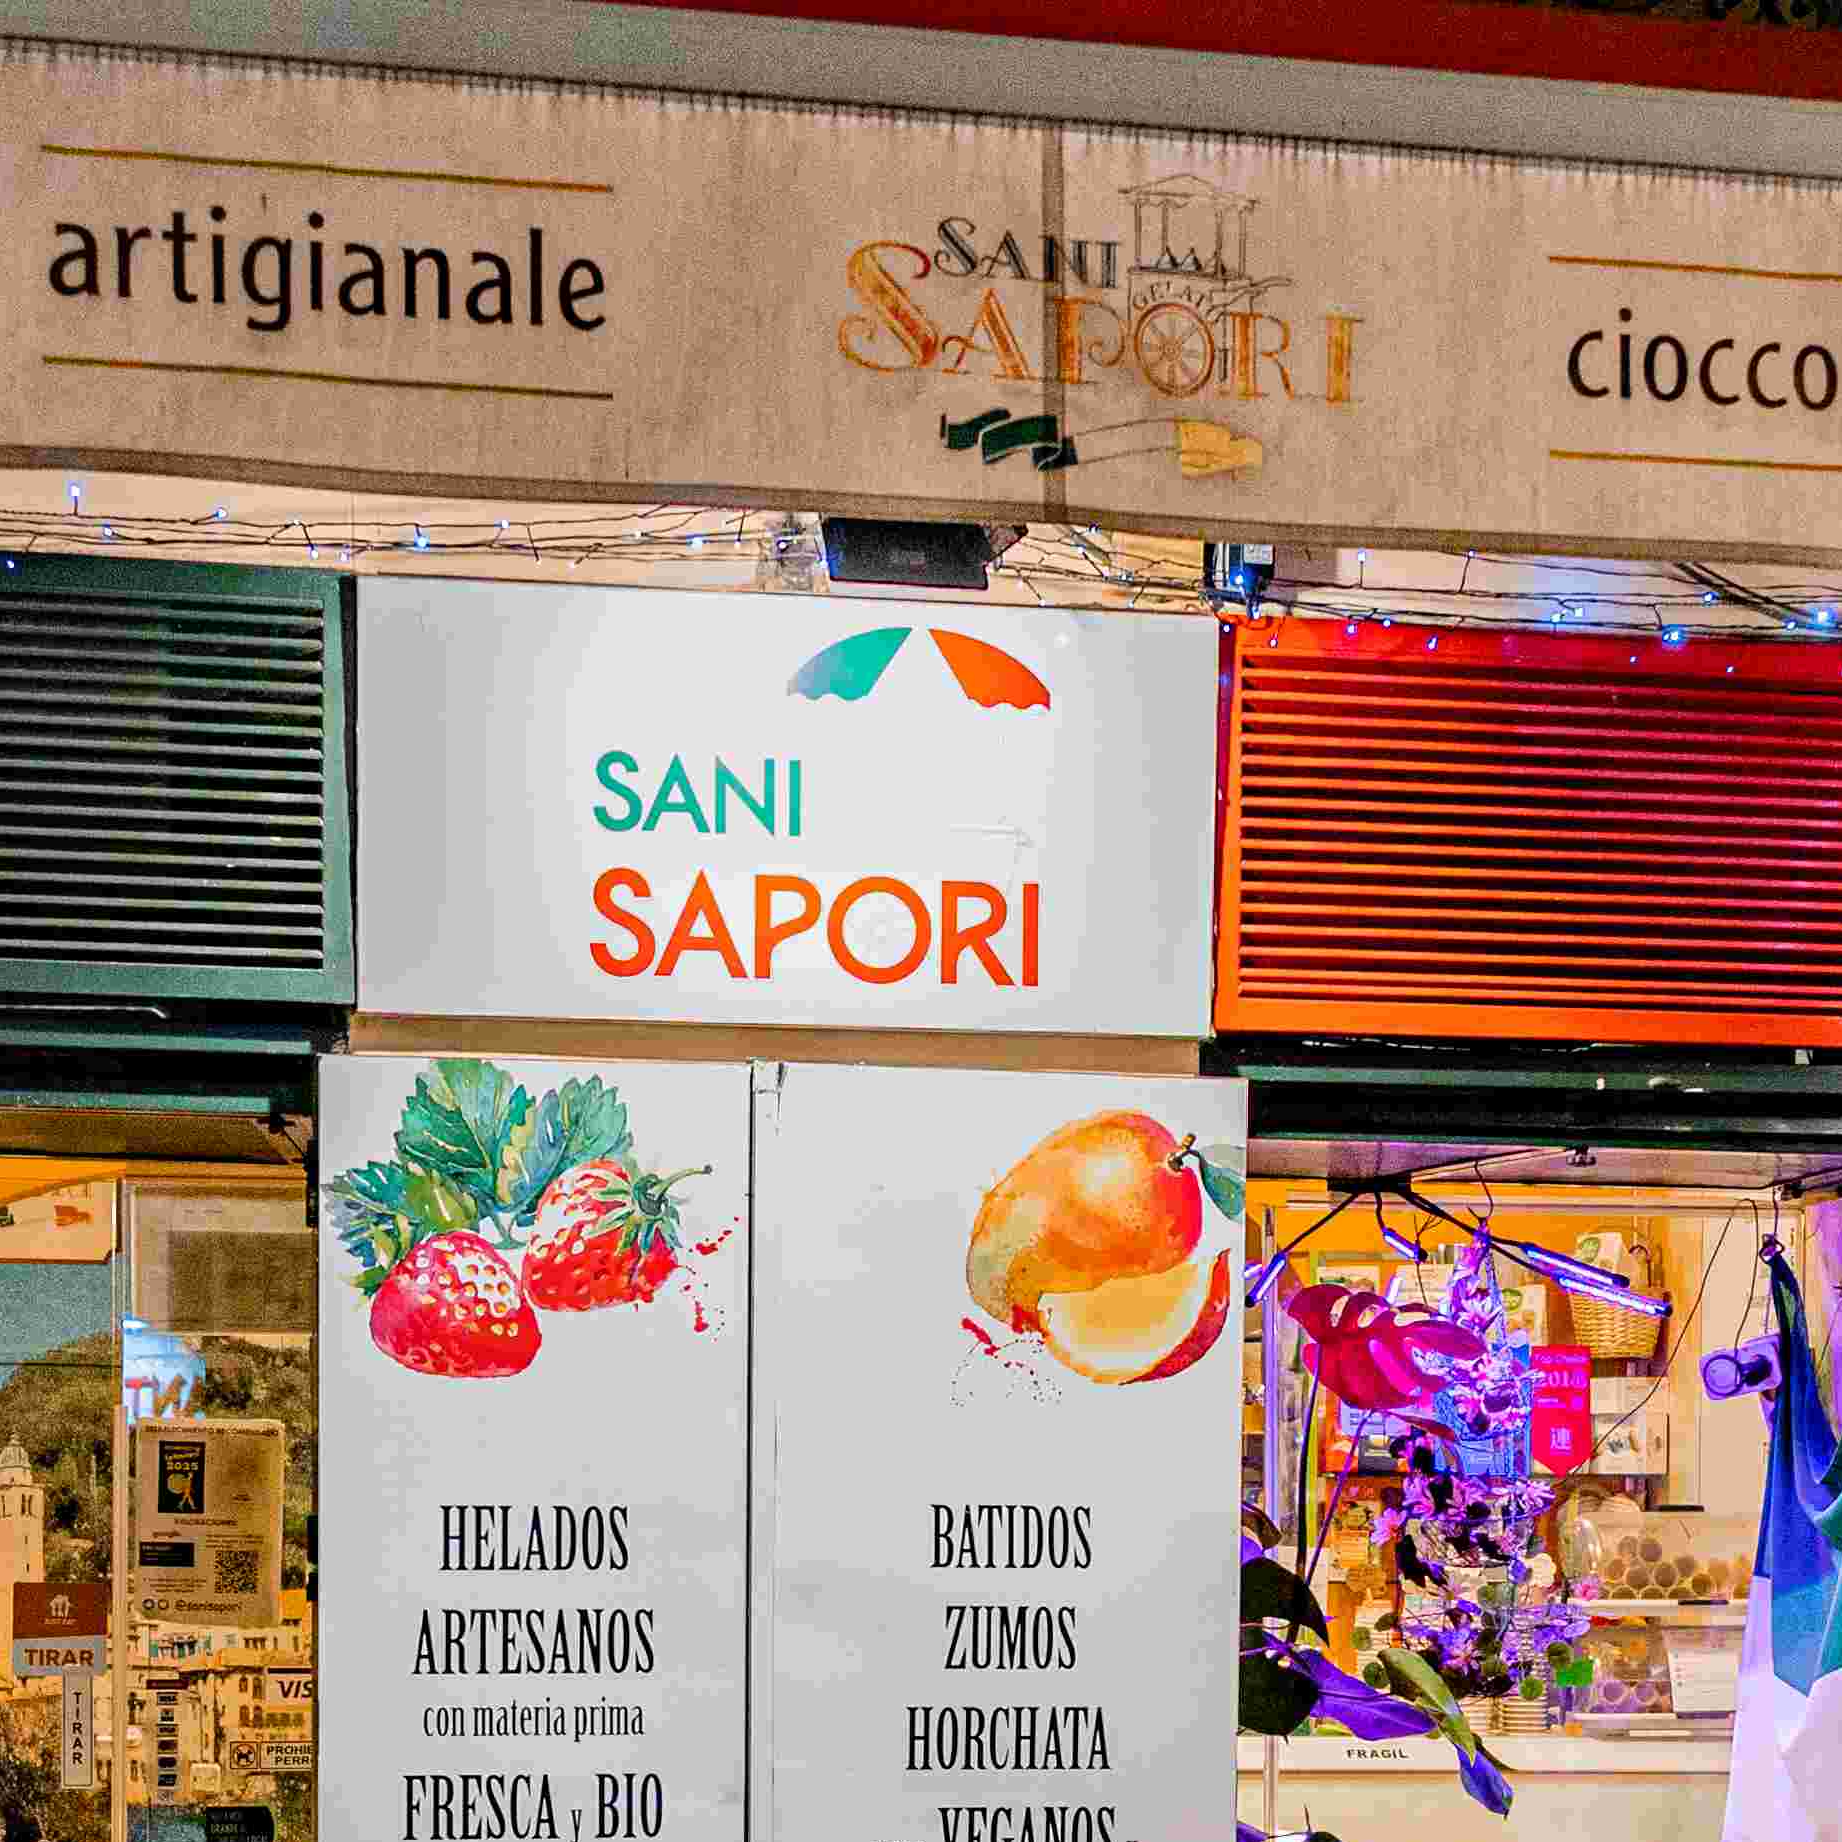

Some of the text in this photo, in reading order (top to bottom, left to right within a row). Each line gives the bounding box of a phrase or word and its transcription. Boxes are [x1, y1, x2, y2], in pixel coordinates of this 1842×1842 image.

[46, 203, 610, 333] artigianale
[934, 217, 1123, 288] SANI
[838, 240, 1364, 407] SAPORI
[593, 750, 802, 836] SANI
[589, 867, 1040, 987] SAPORI
[439, 1505, 630, 1572] HELADOS
[930, 1503, 1092, 1569] BATIDOS
[24, 1648, 94, 1666] TIRAR
[411, 1608, 656, 1675] ARTESANOS
[944, 1604, 1078, 1671] ZUMOS
[278, 1680, 313, 1699] VIS
[423, 1699, 645, 1743] con materia prima
[71, 1690, 84, 1766] TIRAR
[275, 1755, 313, 1765] PERR
[905, 1705, 1110, 1772] HORCHATA
[402, 1773, 559, 1841] FRESCA
[596, 1772, 663, 1839] BIO
